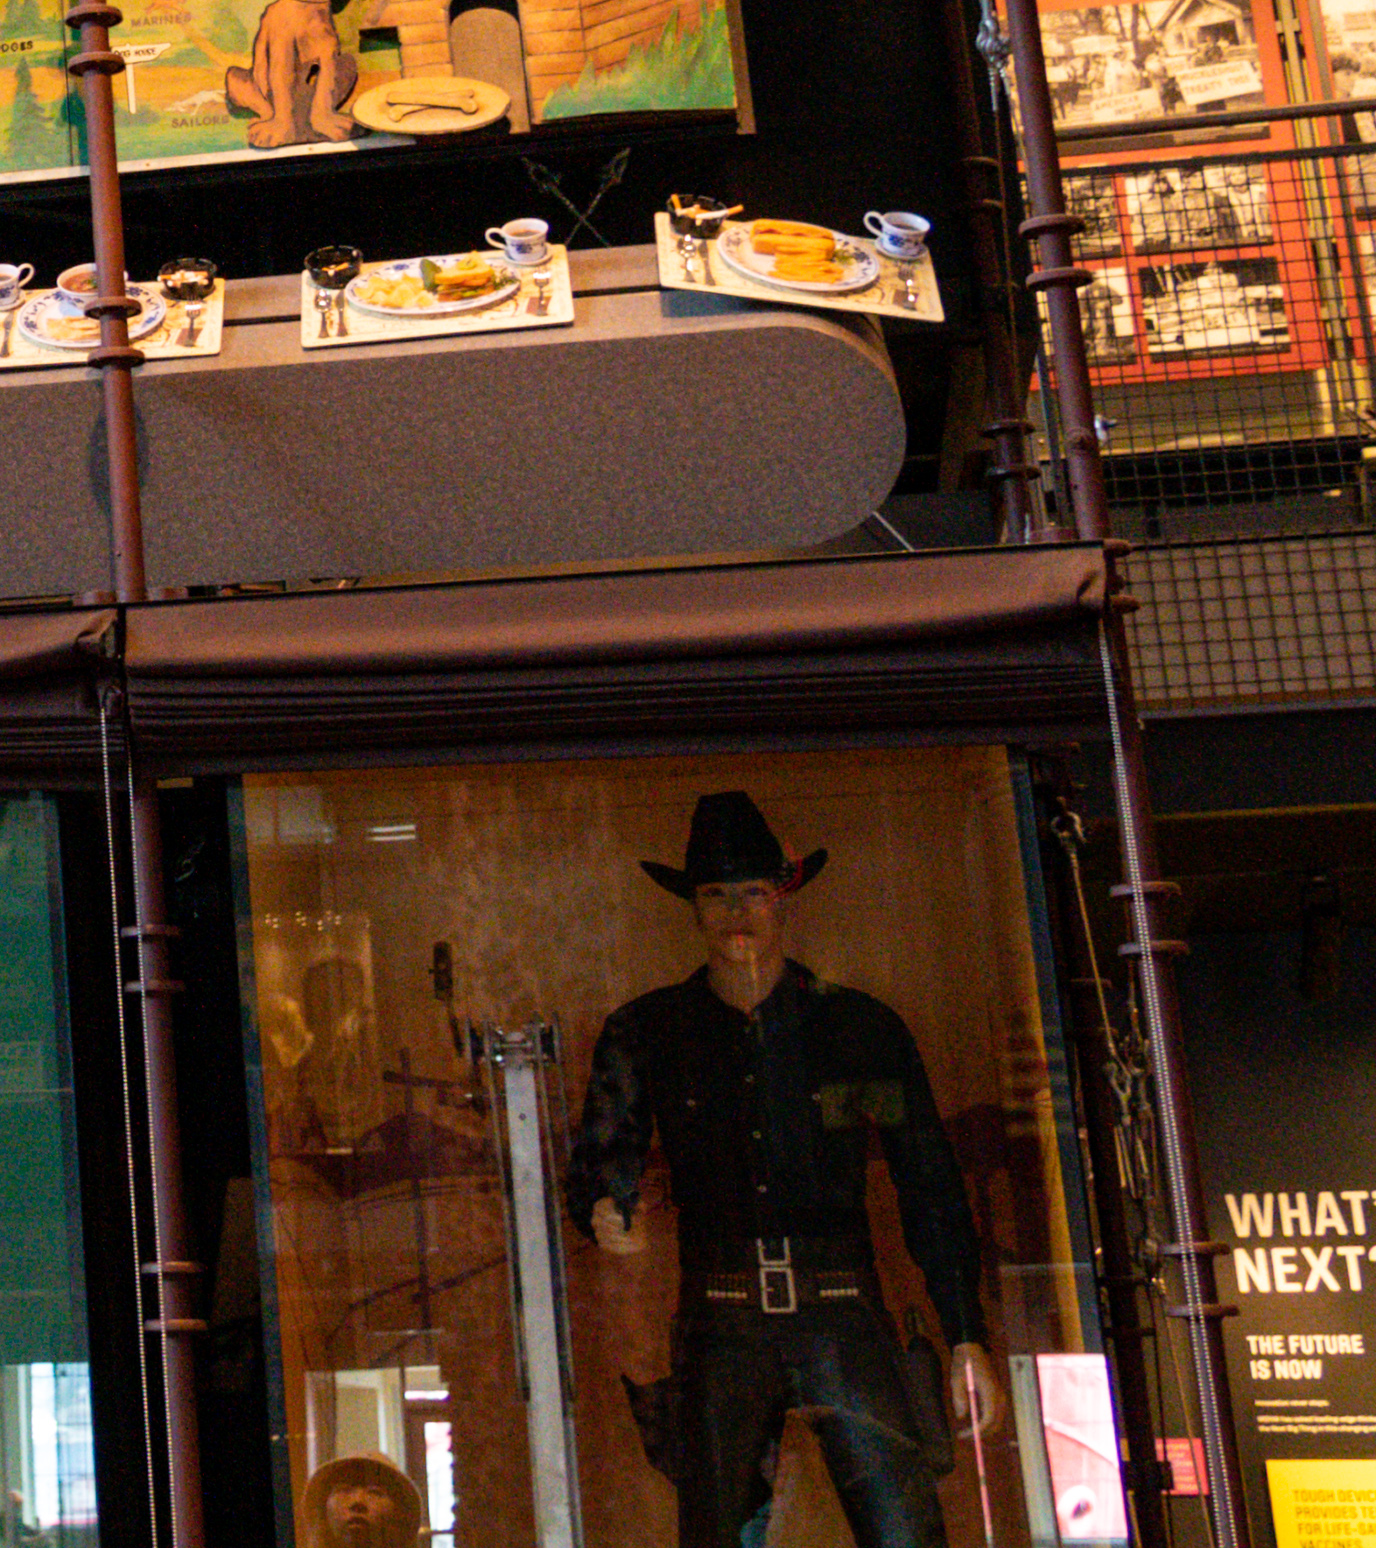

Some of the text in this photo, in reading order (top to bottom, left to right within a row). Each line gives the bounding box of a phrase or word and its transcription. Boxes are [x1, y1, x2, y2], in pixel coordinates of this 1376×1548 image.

[131, 11, 191, 27] MARINES
[171, 115, 230, 129] SAILORS
[1246, 1333, 1365, 1355] THE FUTURE
[1249, 1358, 1323, 1380] IS NOW
[1294, 1489, 1335, 1502] TOUGH
[1295, 1506, 1358, 1520] PROVIDES
[1298, 1522, 1323, 1536] FOR
